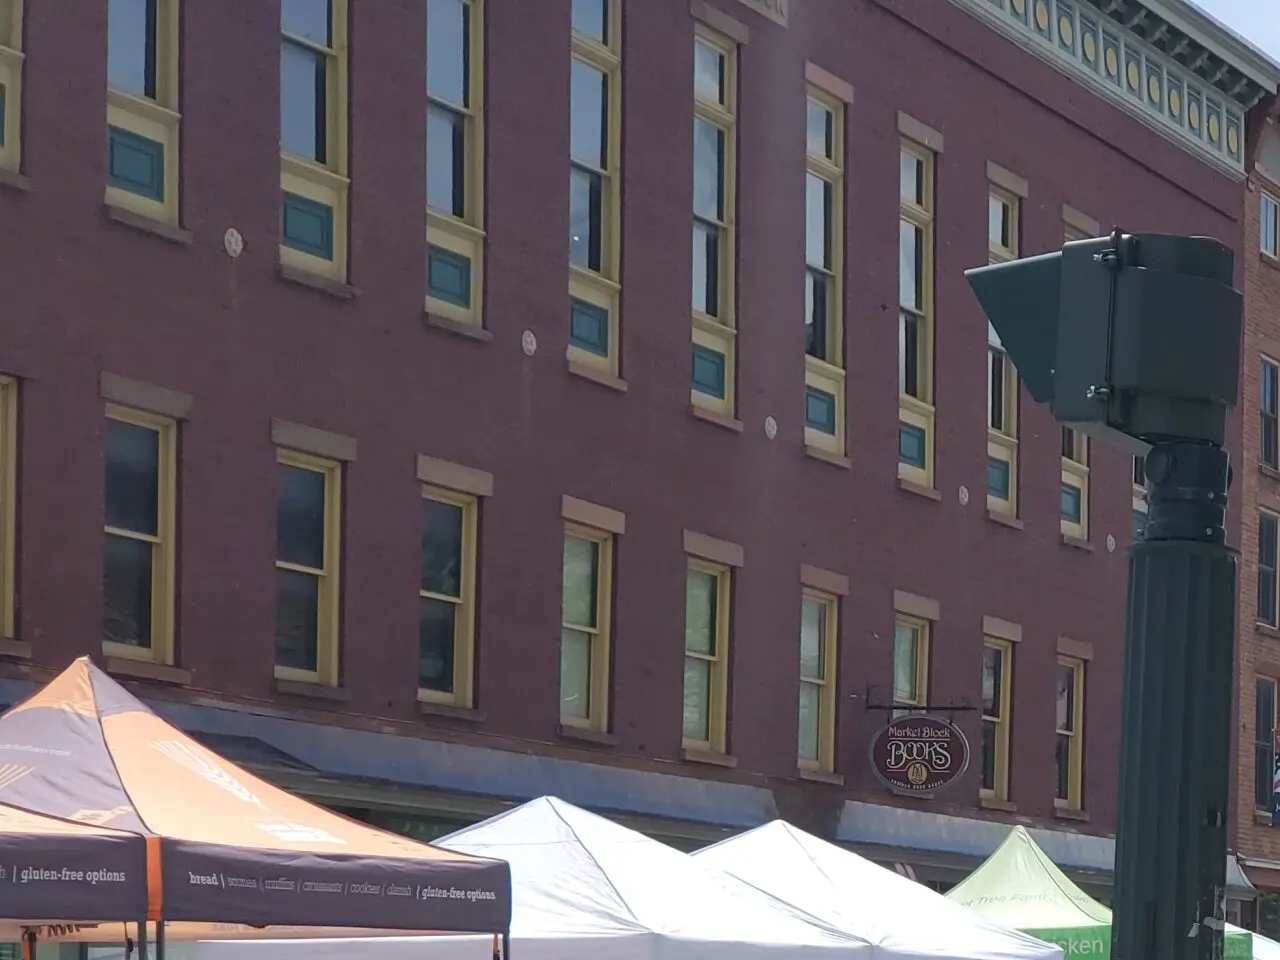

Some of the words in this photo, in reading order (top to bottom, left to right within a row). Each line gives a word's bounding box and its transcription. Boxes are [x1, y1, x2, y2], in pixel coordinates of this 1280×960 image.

[888, 726, 921, 738] Market
[922, 726, 950, 738] Block
[886, 740, 951, 770] BOOKS
[21, 867, 83, 882] gluten-free
[86, 869, 126, 884] options
[189, 872, 219, 885] bread
[422, 886, 466, 900] gluten-free
[467, 888, 496, 902] options
